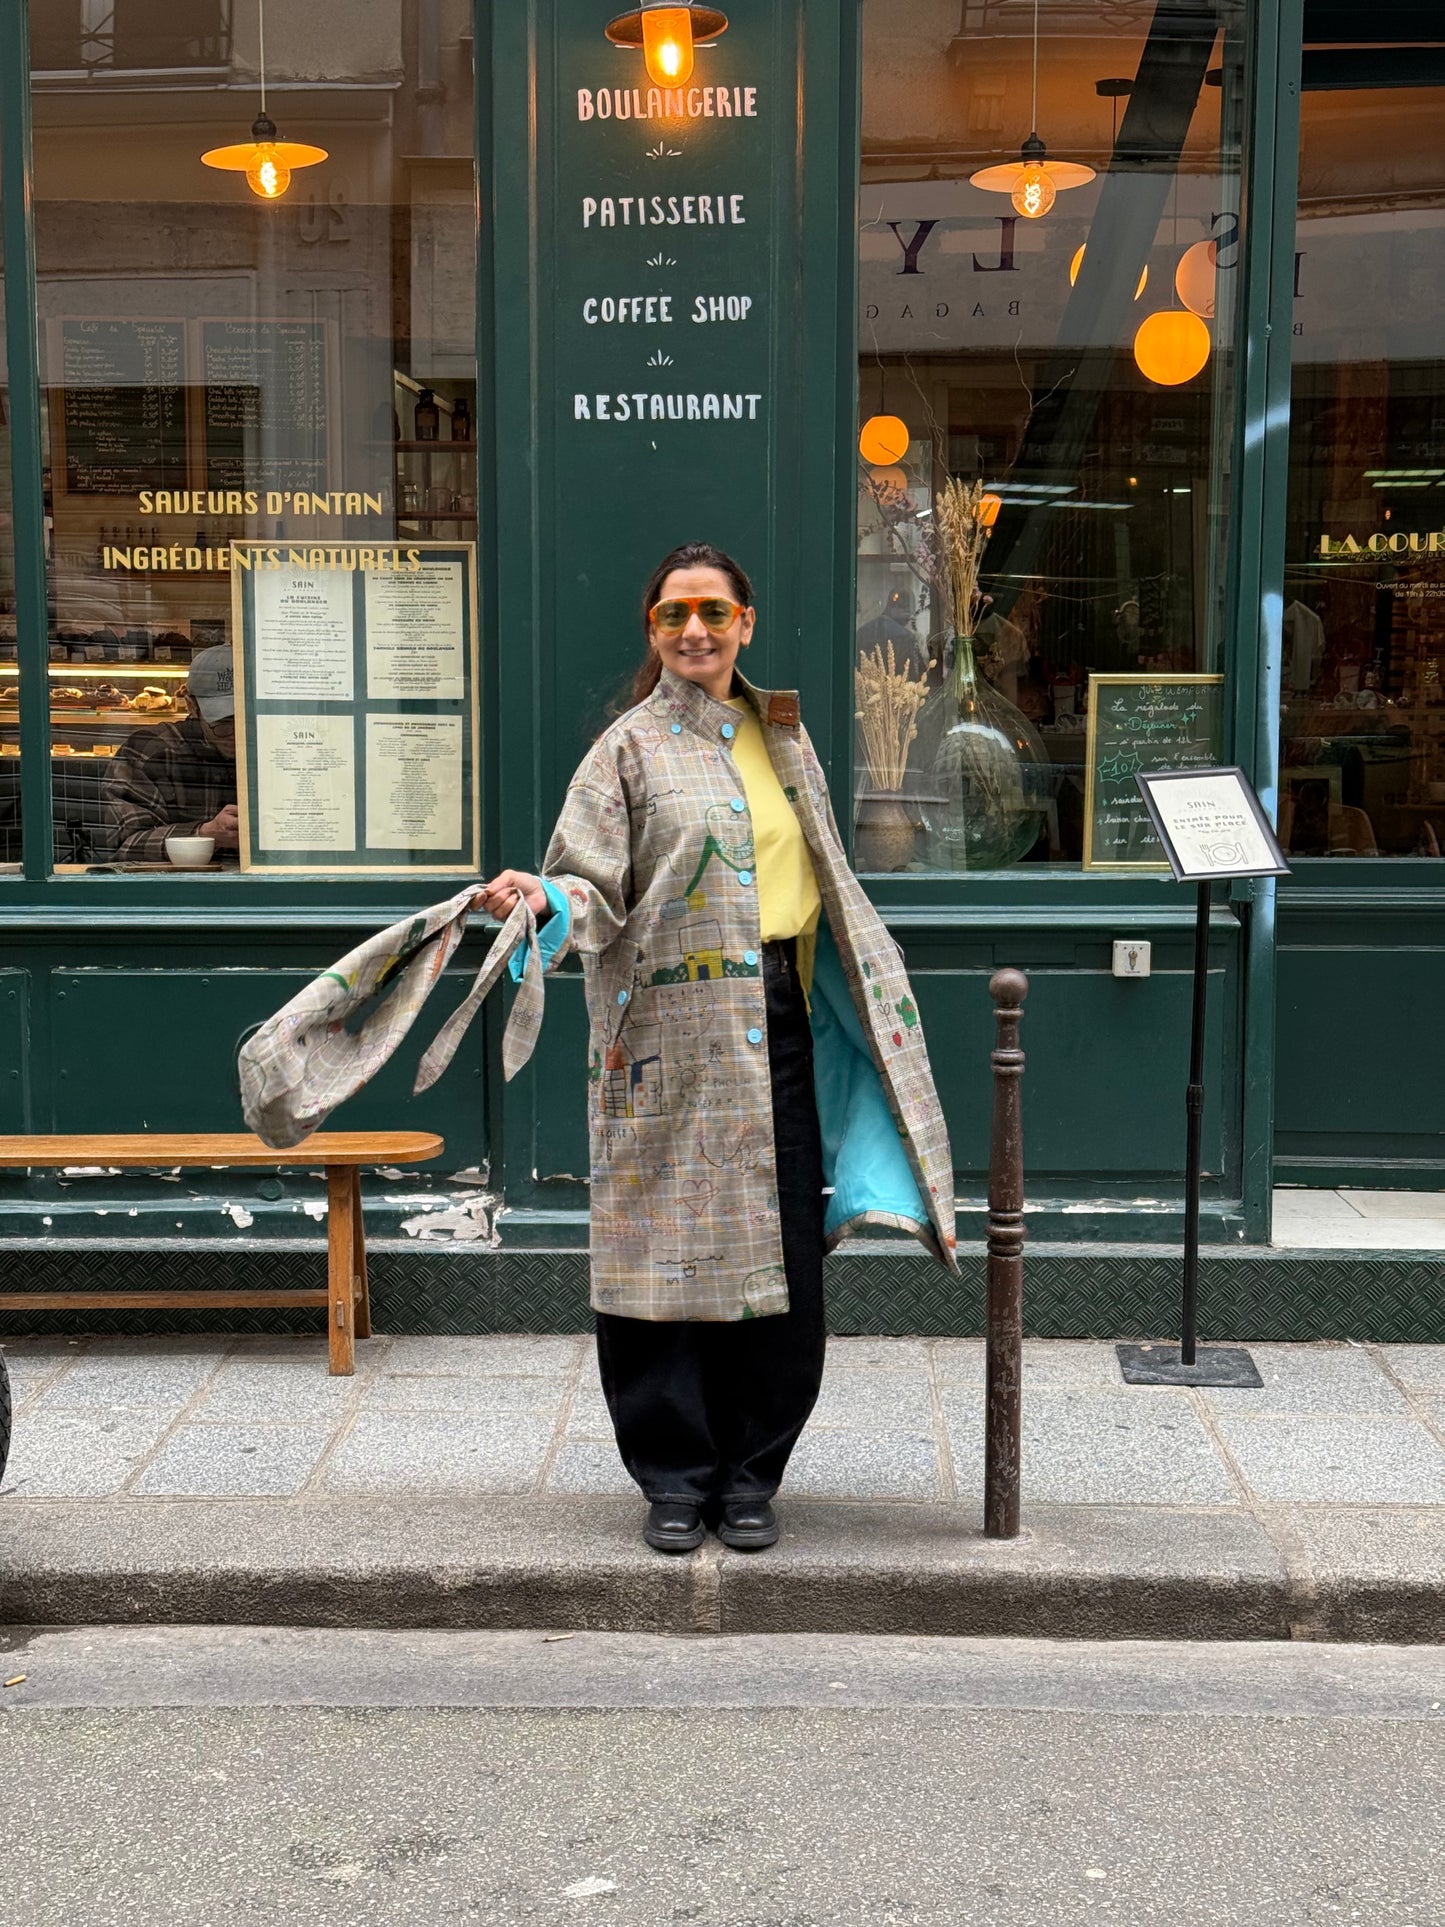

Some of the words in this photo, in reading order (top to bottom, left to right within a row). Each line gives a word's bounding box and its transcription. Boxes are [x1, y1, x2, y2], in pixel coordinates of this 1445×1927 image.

[577, 87, 758, 121] BOULANGERIE
[582, 195, 746, 228] PATISSERIE
[583, 296, 673, 324] COFFEE
[691, 296, 753, 323] SHOP
[574, 394, 762, 420] RESTAURANT
[139, 491, 258, 515] SAVEURS
[266, 491, 382, 515] D'ANTAN
[1321, 534, 1360, 553] LA
[103, 542, 280, 571] INGRÉDIENTS
[288, 548, 420, 572] NATURELS
[1187, 800, 1216, 809] SAIN
[1215, 820, 1248, 828] PLACE
